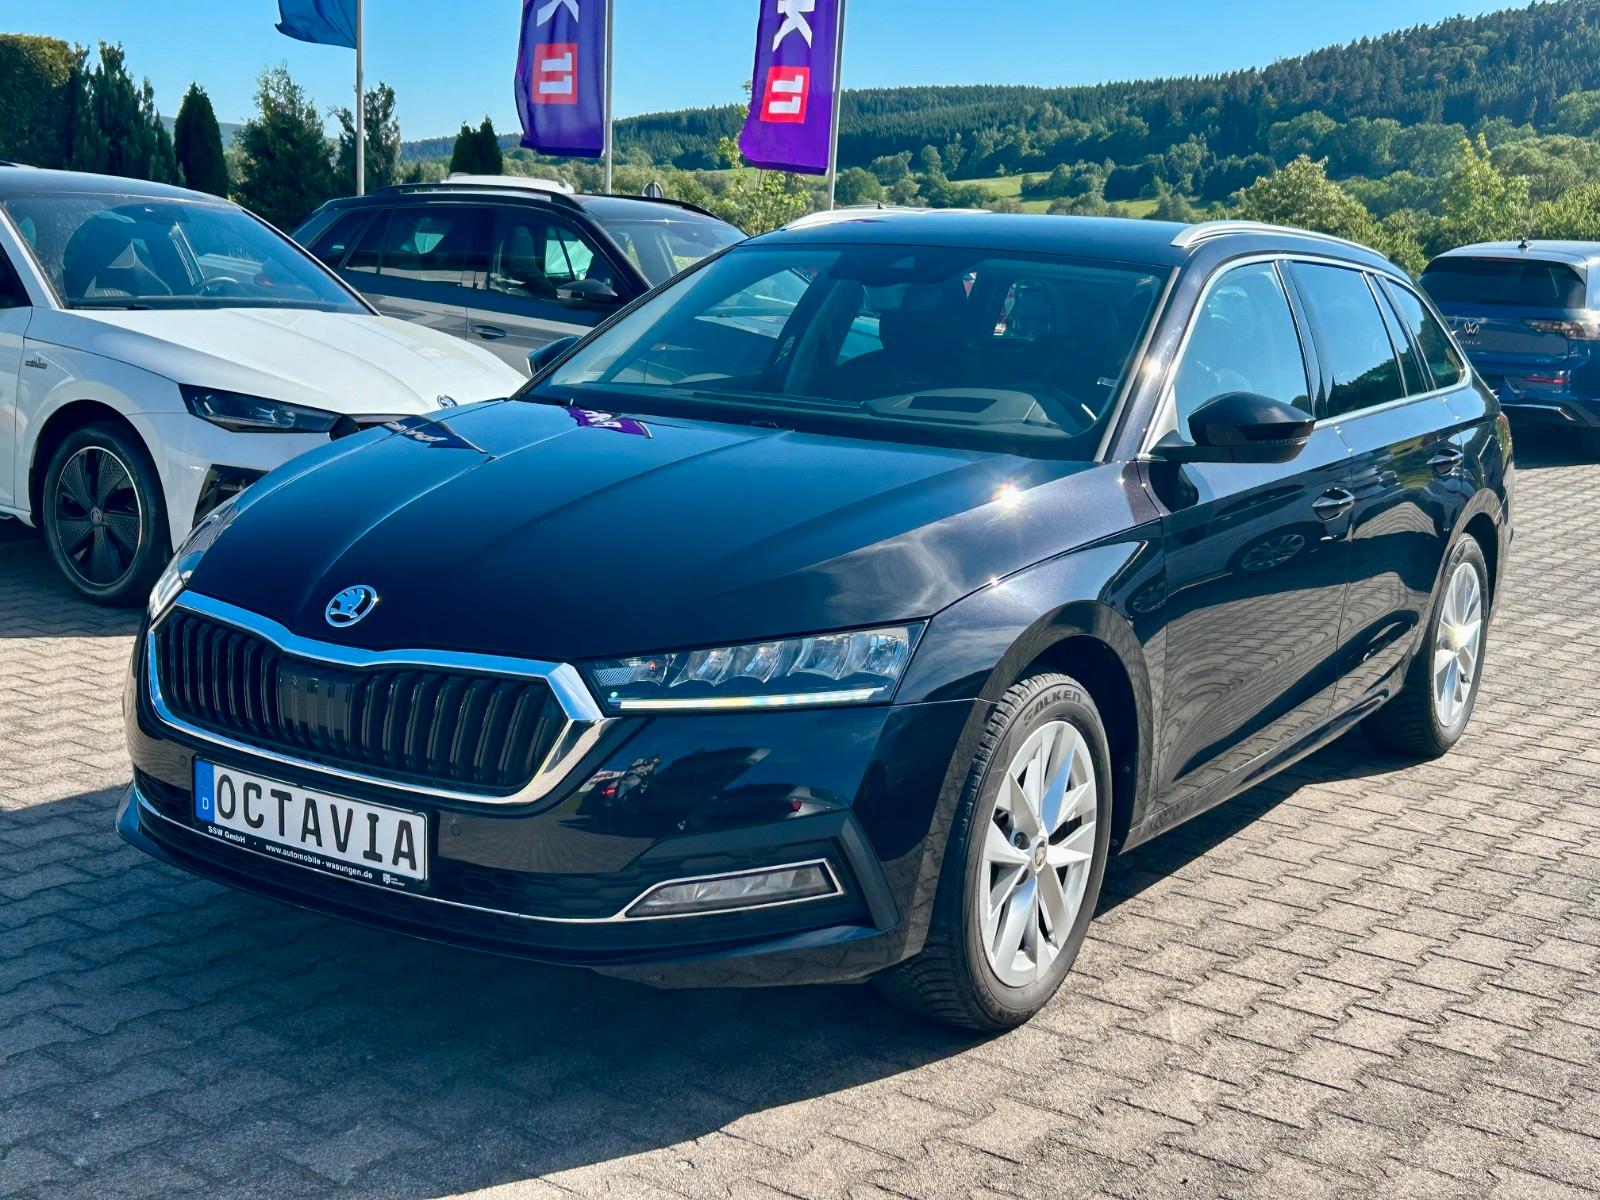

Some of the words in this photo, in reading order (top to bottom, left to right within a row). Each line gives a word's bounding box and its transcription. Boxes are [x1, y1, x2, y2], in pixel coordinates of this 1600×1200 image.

[539, 52, 573, 94] 11
[768, 74, 804, 115] 11
[202, 797, 209, 810] D
[216, 774, 417, 871] OCTAVIA
[207, 825, 223, 837] SSW
[224, 830, 246, 844] GmbH
